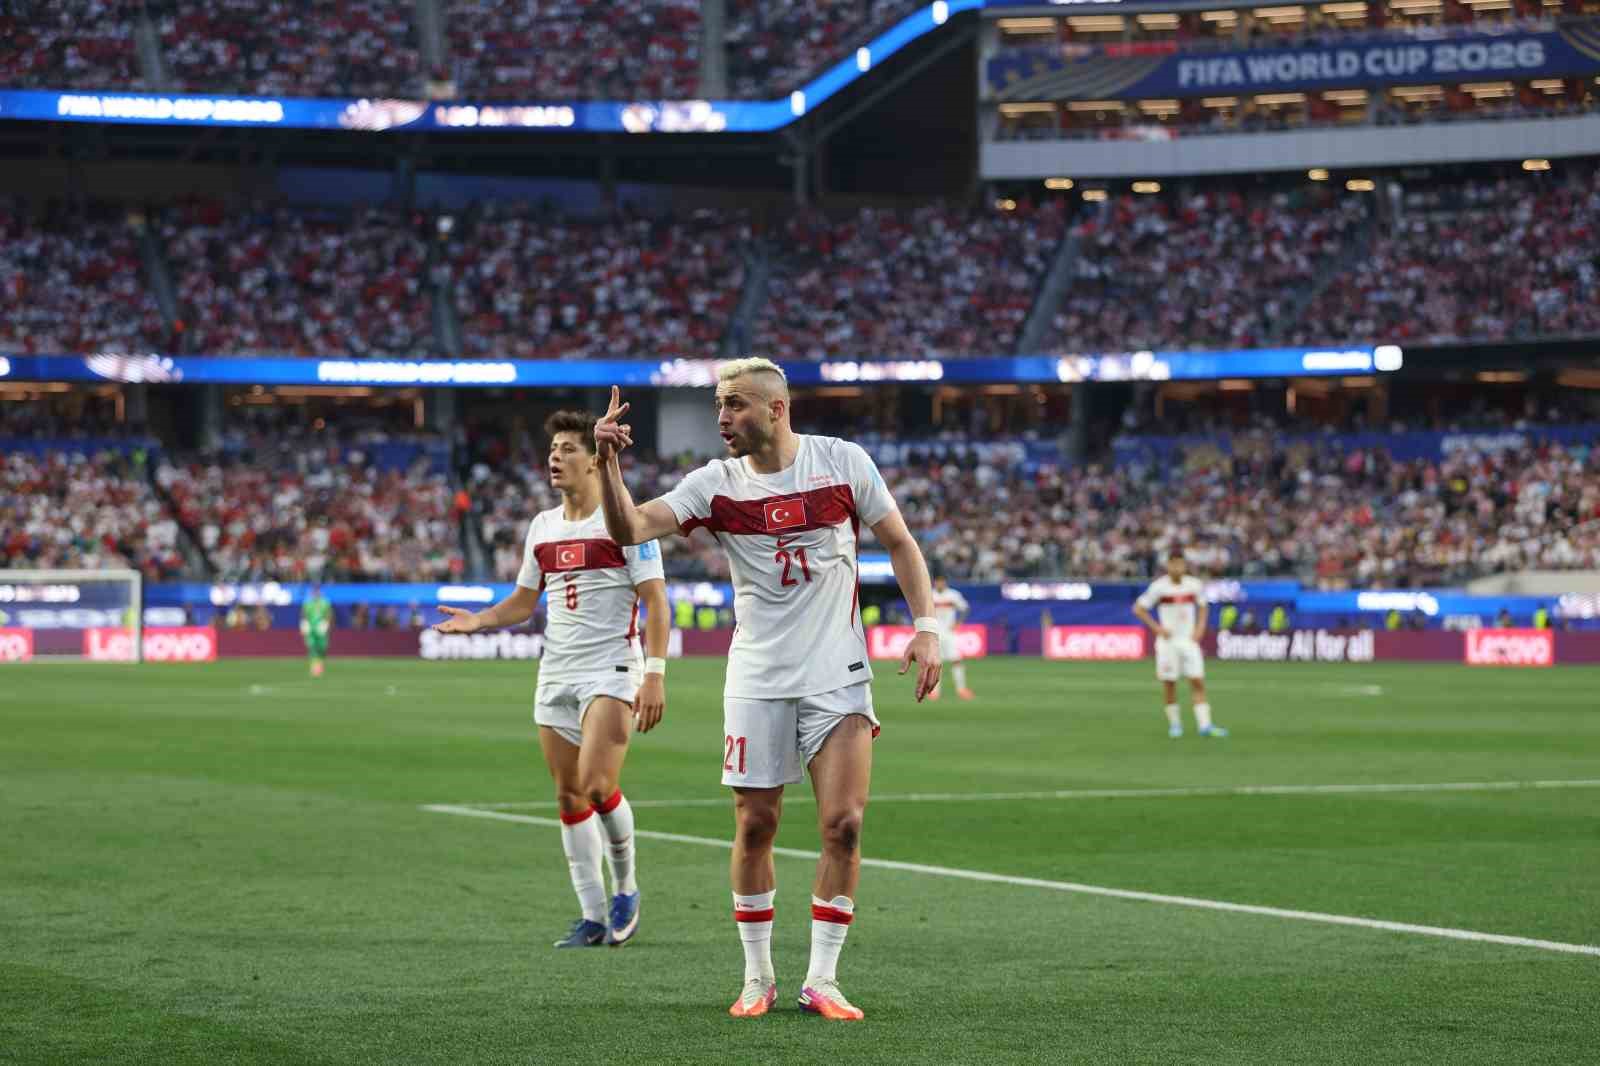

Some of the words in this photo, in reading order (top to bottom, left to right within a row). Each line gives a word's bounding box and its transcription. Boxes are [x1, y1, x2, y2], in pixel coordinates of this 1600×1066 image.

[1177, 55, 1247, 88] FIFA
[1247, 50, 1360, 83] WORLD
[1364, 46, 1428, 77] CUP
[1431, 40, 1545, 71] 2026
[775, 547, 813, 587] 21
[1217, 628, 1289, 660] Smarter
[1347, 628, 1374, 662] all
[1467, 628, 1551, 664] Lenovo
[724, 734, 747, 775] 21
